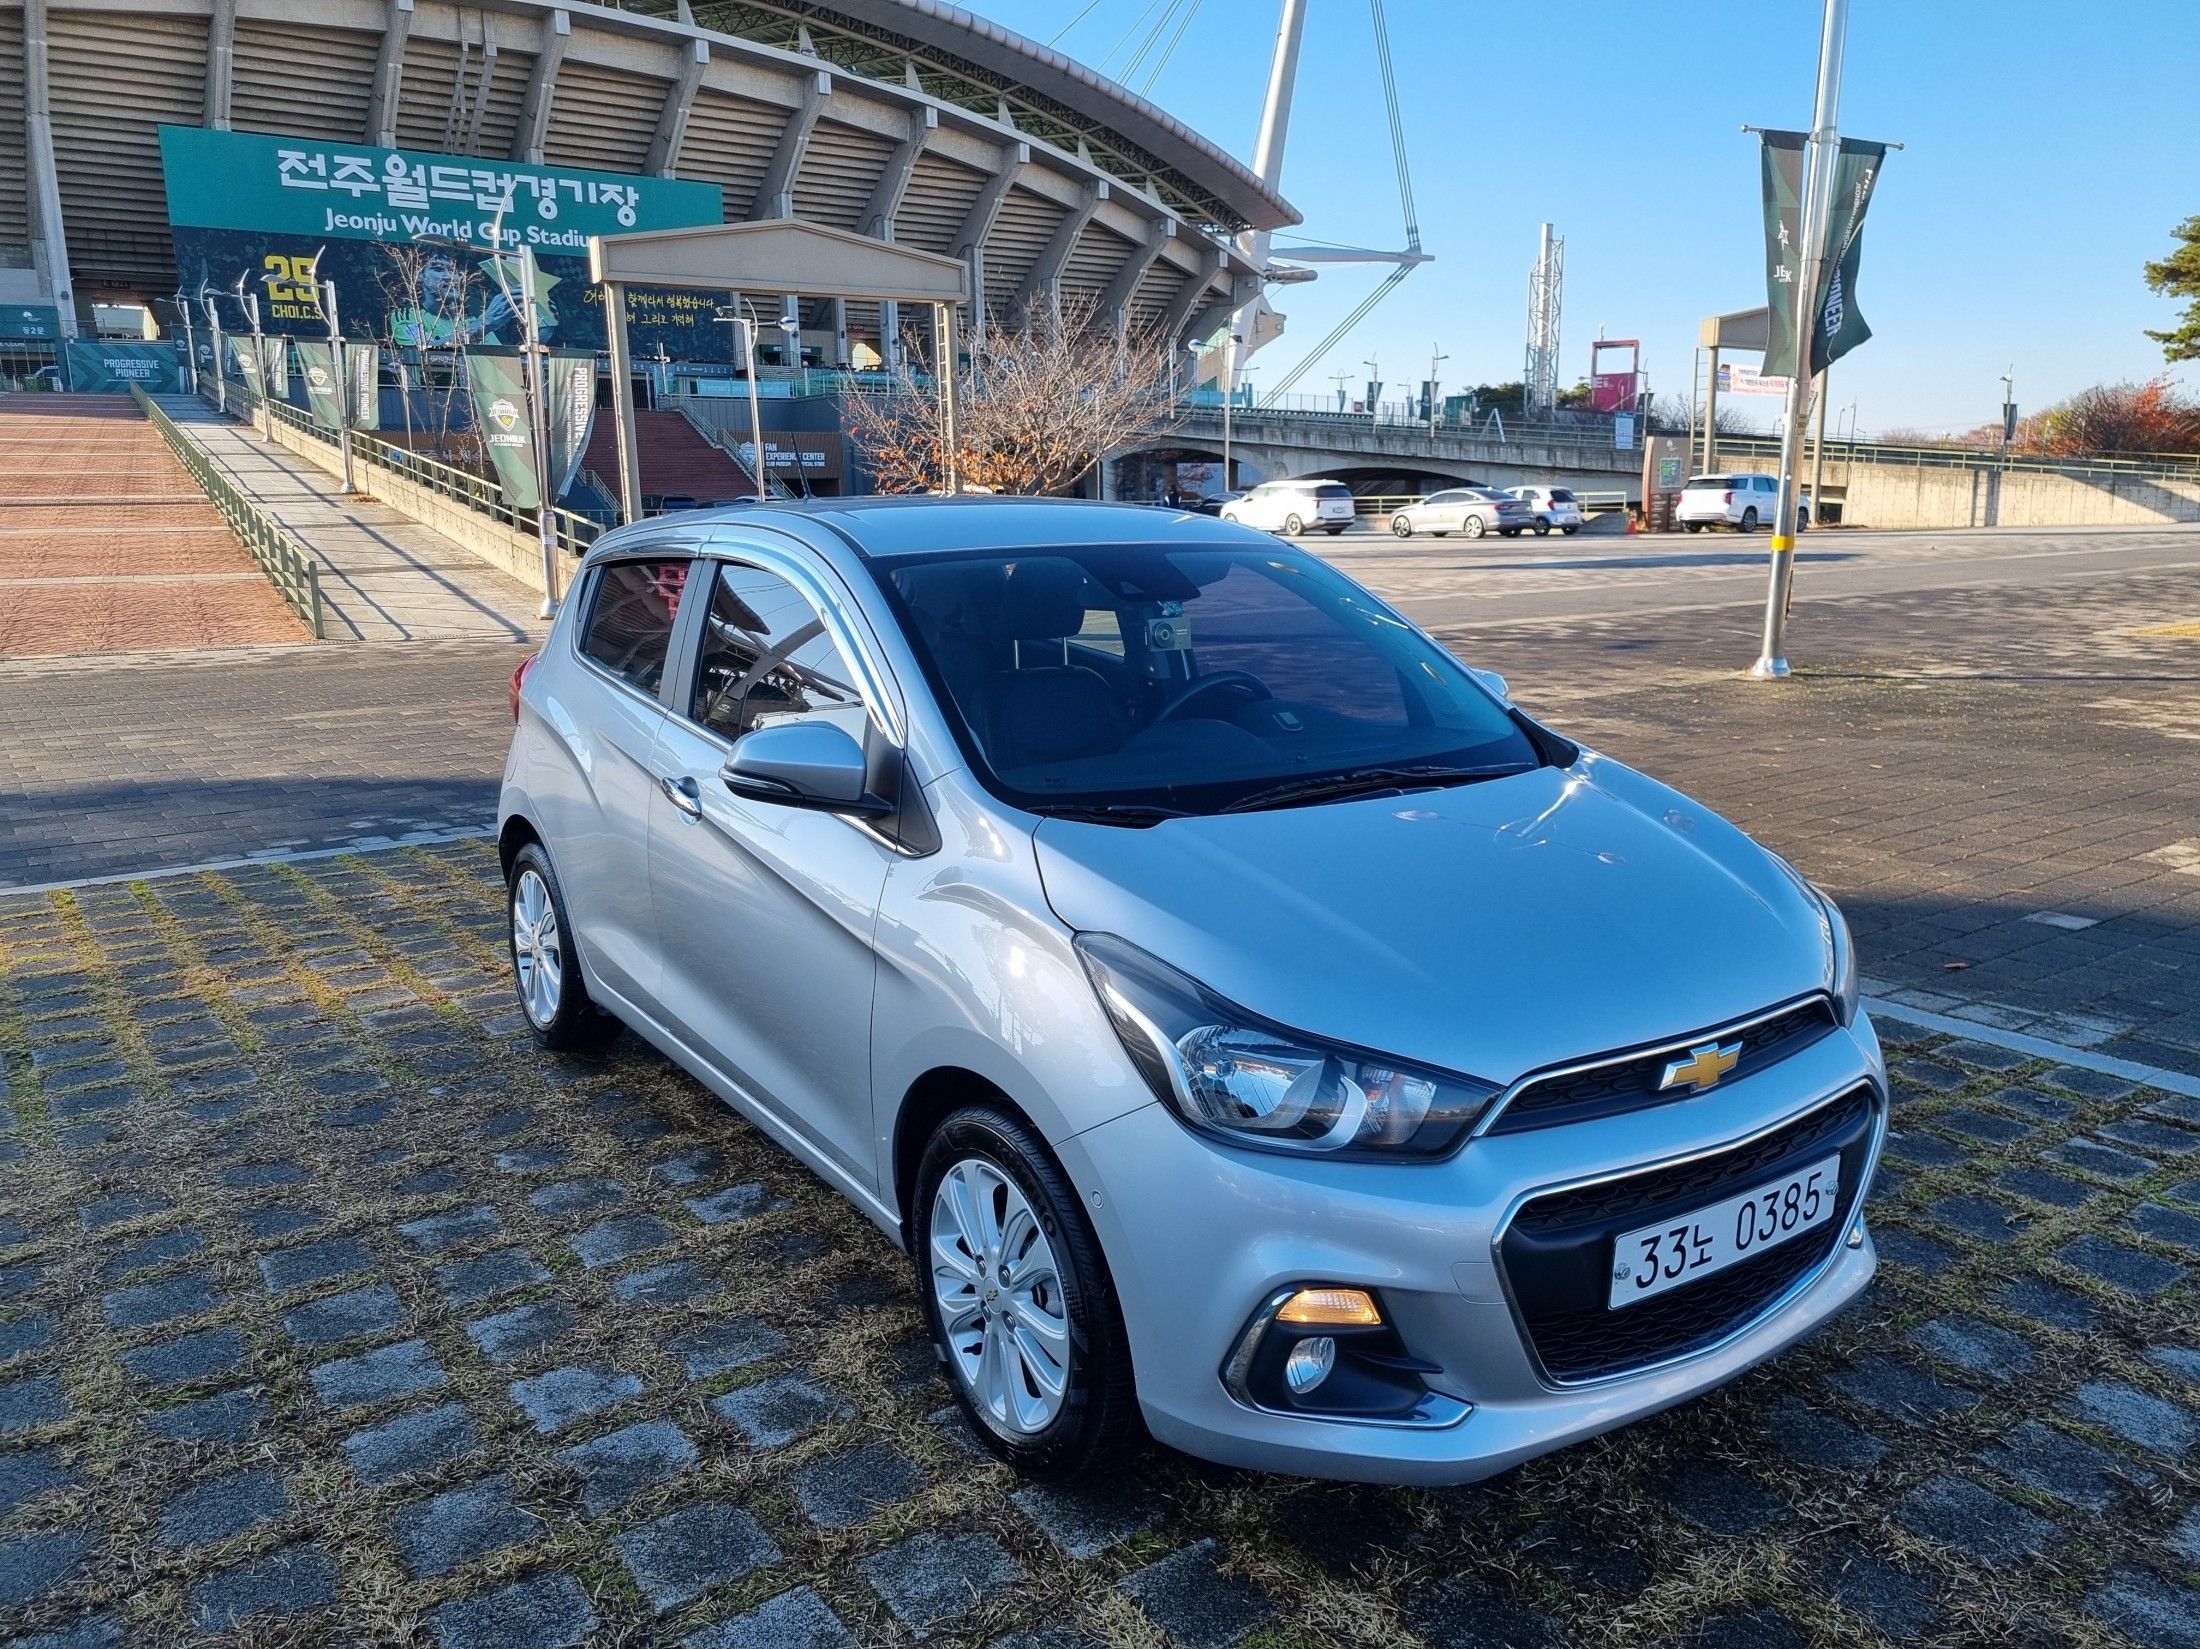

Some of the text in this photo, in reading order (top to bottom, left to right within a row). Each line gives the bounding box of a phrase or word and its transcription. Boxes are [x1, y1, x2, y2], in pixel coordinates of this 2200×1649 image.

[277, 150, 639, 227] 전주월드컵경기장
[325, 208, 397, 233] Jeonju
[400, 214, 473, 240] World
[478, 222, 522, 246] Cup
[264, 255, 321, 302] 25
[103, 358, 160, 369] PROGRESSIVE
[115, 368, 151, 378] PIONEER
[574, 367, 588, 439] PROGRESSIVE
[764, 443, 777, 452] FAN
[802, 452, 825, 461] CENTER
[1636, 1171, 1823, 1289] 33노 0385
